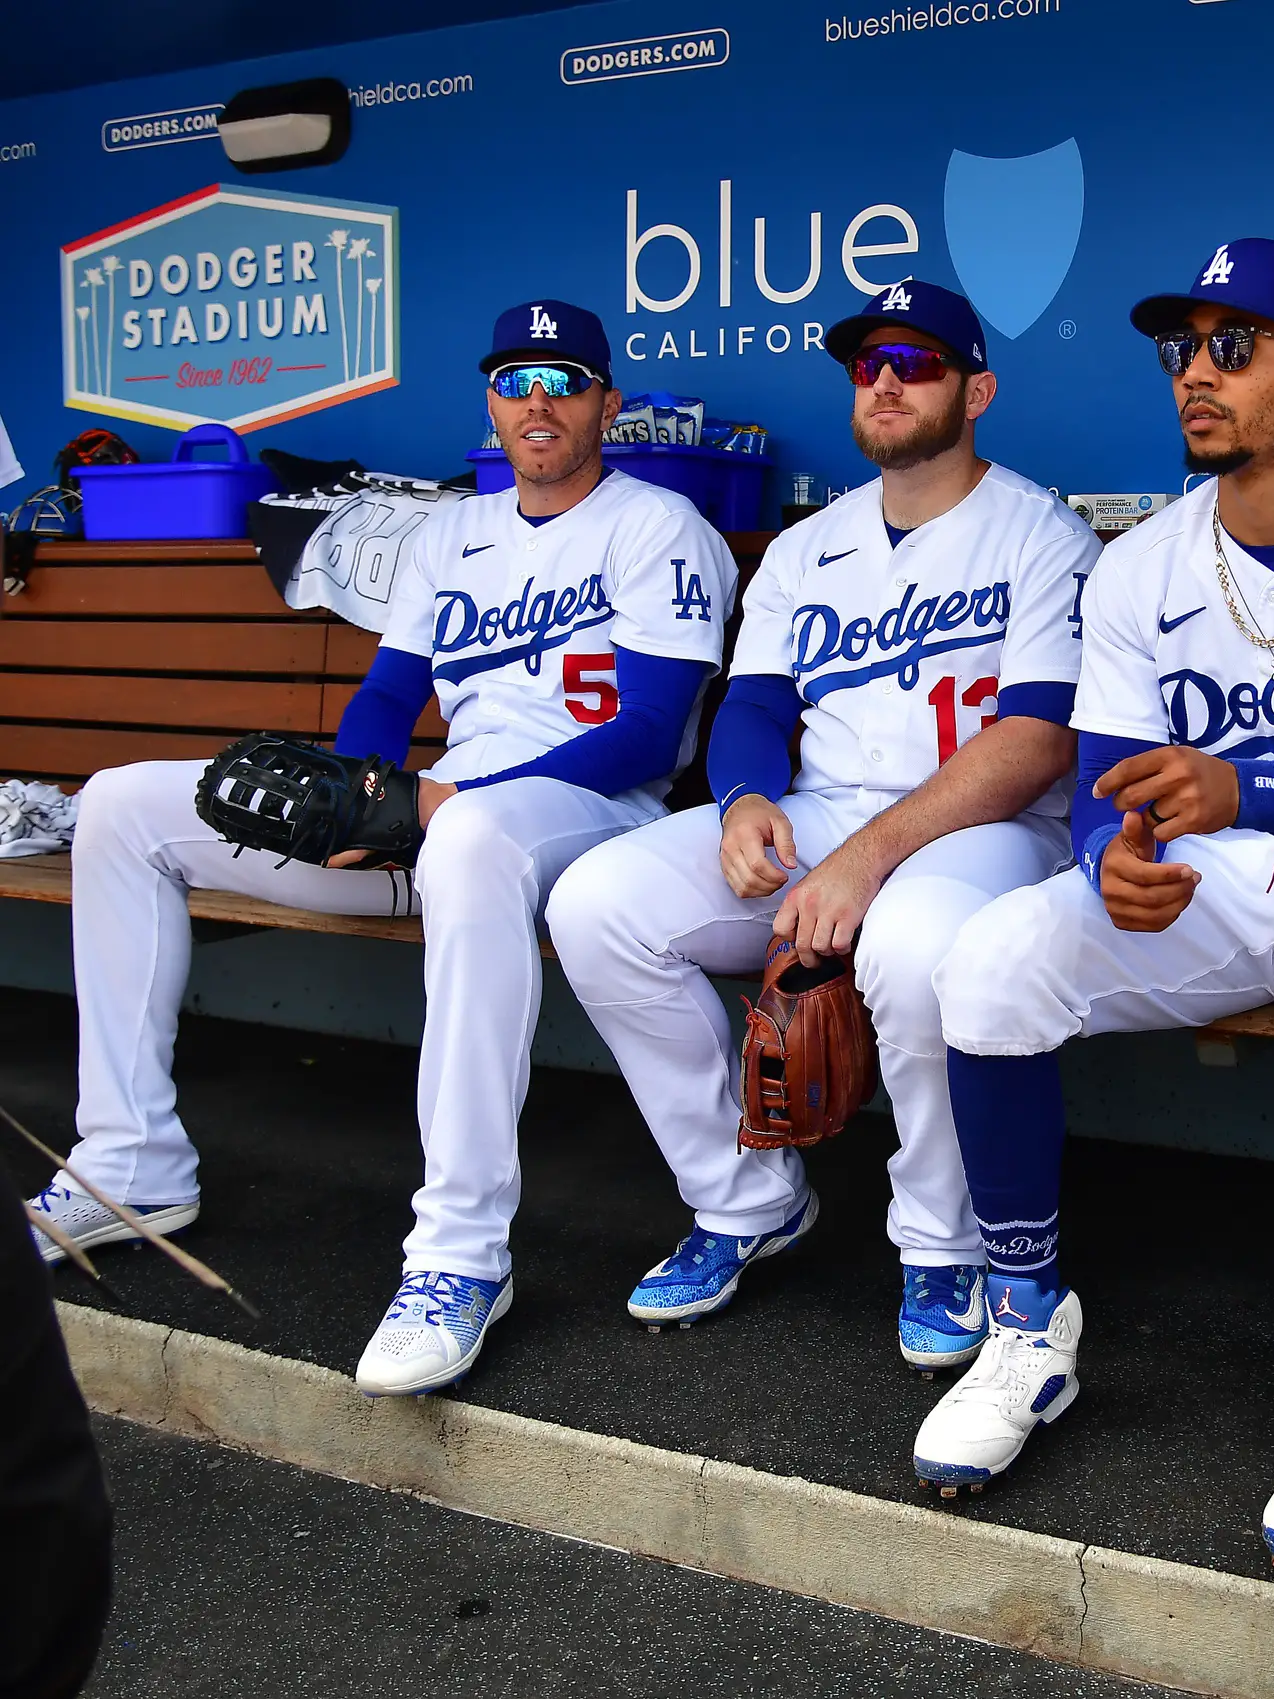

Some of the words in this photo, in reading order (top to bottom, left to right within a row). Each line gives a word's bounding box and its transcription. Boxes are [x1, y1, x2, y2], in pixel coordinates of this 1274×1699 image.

[572, 39, 715, 75] DODGERS.COM
[347, 74, 473, 108] hieldca.com
[111, 113, 217, 143] DODGERS.COM
[625, 179, 919, 314] blue
[1199, 244, 1235, 287] LA
[129, 240, 318, 298] DODGER
[882, 284, 913, 312] LA
[122, 293, 329, 350] STADIUM
[529, 305, 558, 339] LA
[625, 321, 826, 361] CALIFOR
[174, 361, 223, 389] Since
[227, 356, 273, 386] 1962
[1095, 507, 1124, 515] PROTEIN
[1124, 507, 1139, 515] BAR
[670, 558, 711, 623] LA
[432, 573, 615, 677] Dodgers
[791, 581, 1011, 691] Dodgers
[562, 652, 620, 725] 5
